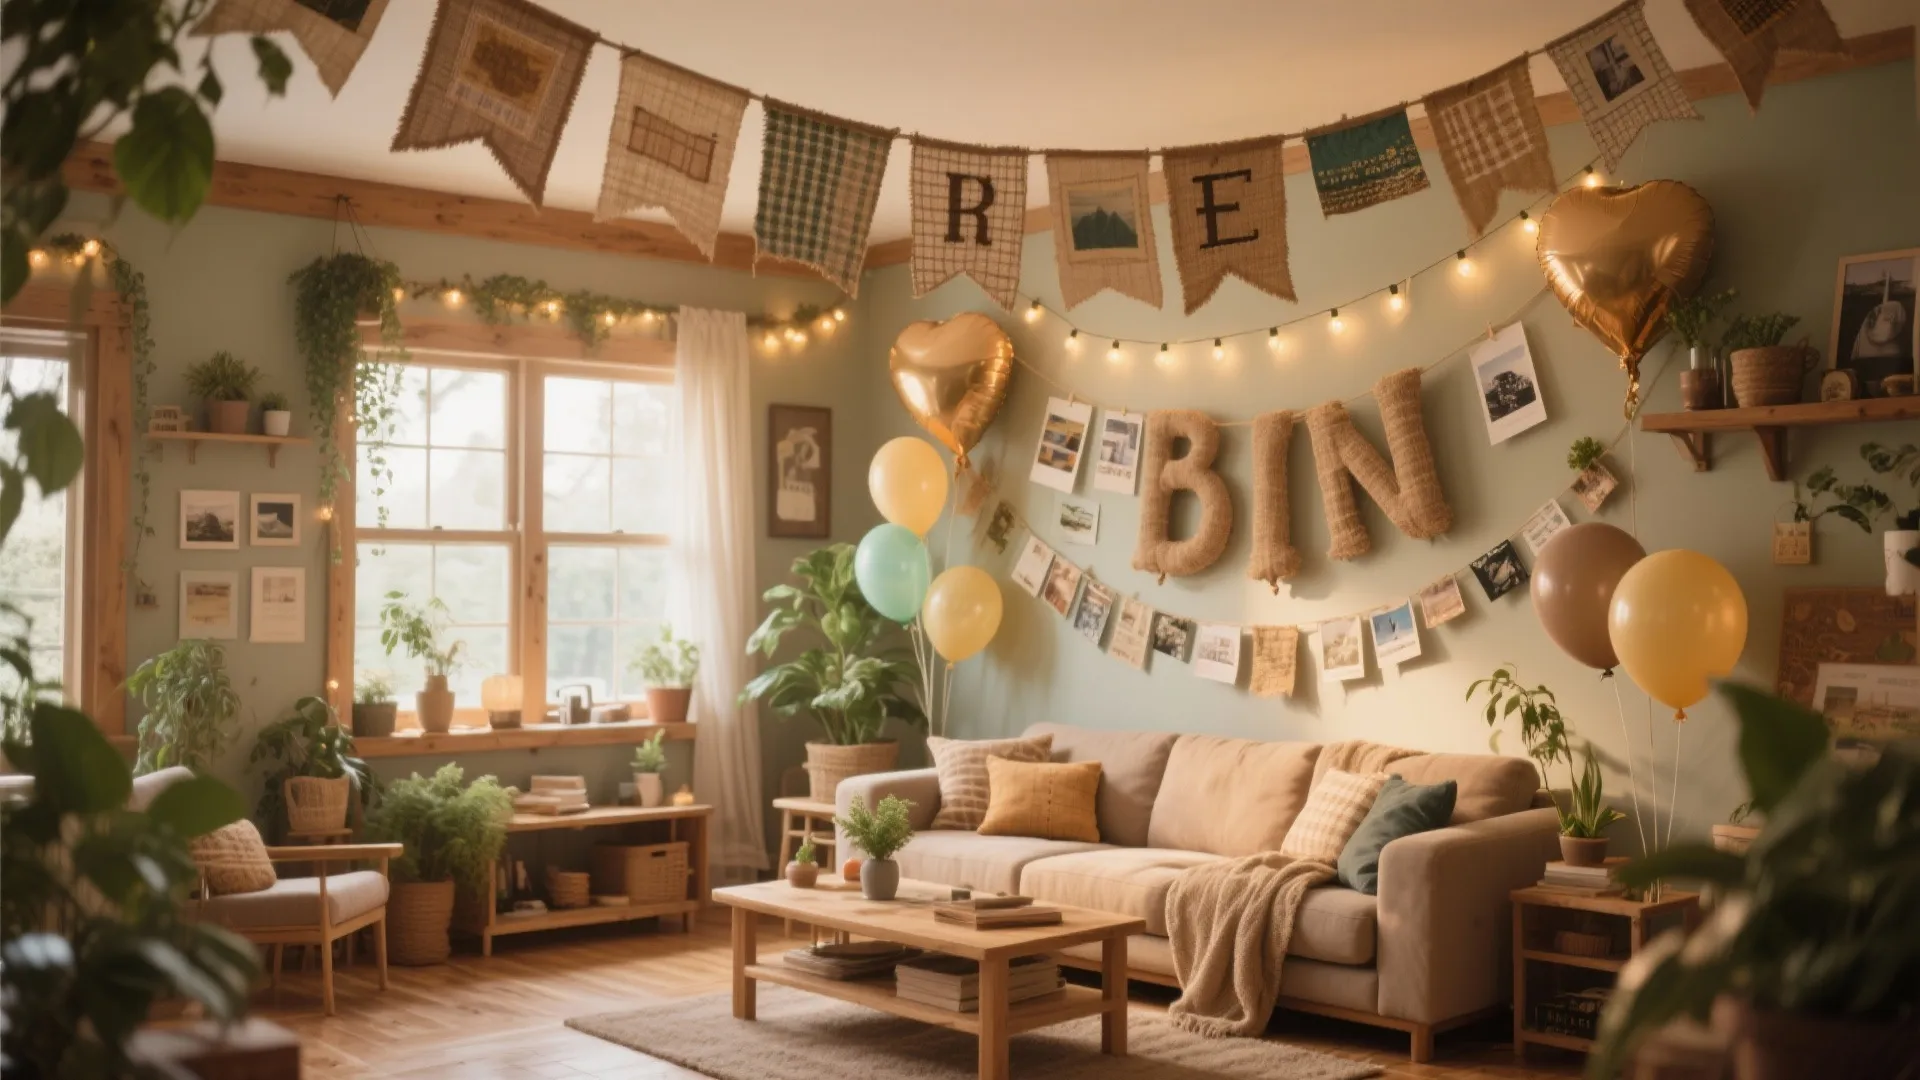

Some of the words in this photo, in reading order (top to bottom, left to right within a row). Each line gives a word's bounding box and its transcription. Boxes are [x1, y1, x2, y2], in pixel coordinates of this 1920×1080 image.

[944, 172, 995, 246] R
[1192, 169, 1259, 249] E
[1132, 367, 1454, 590] BIN
